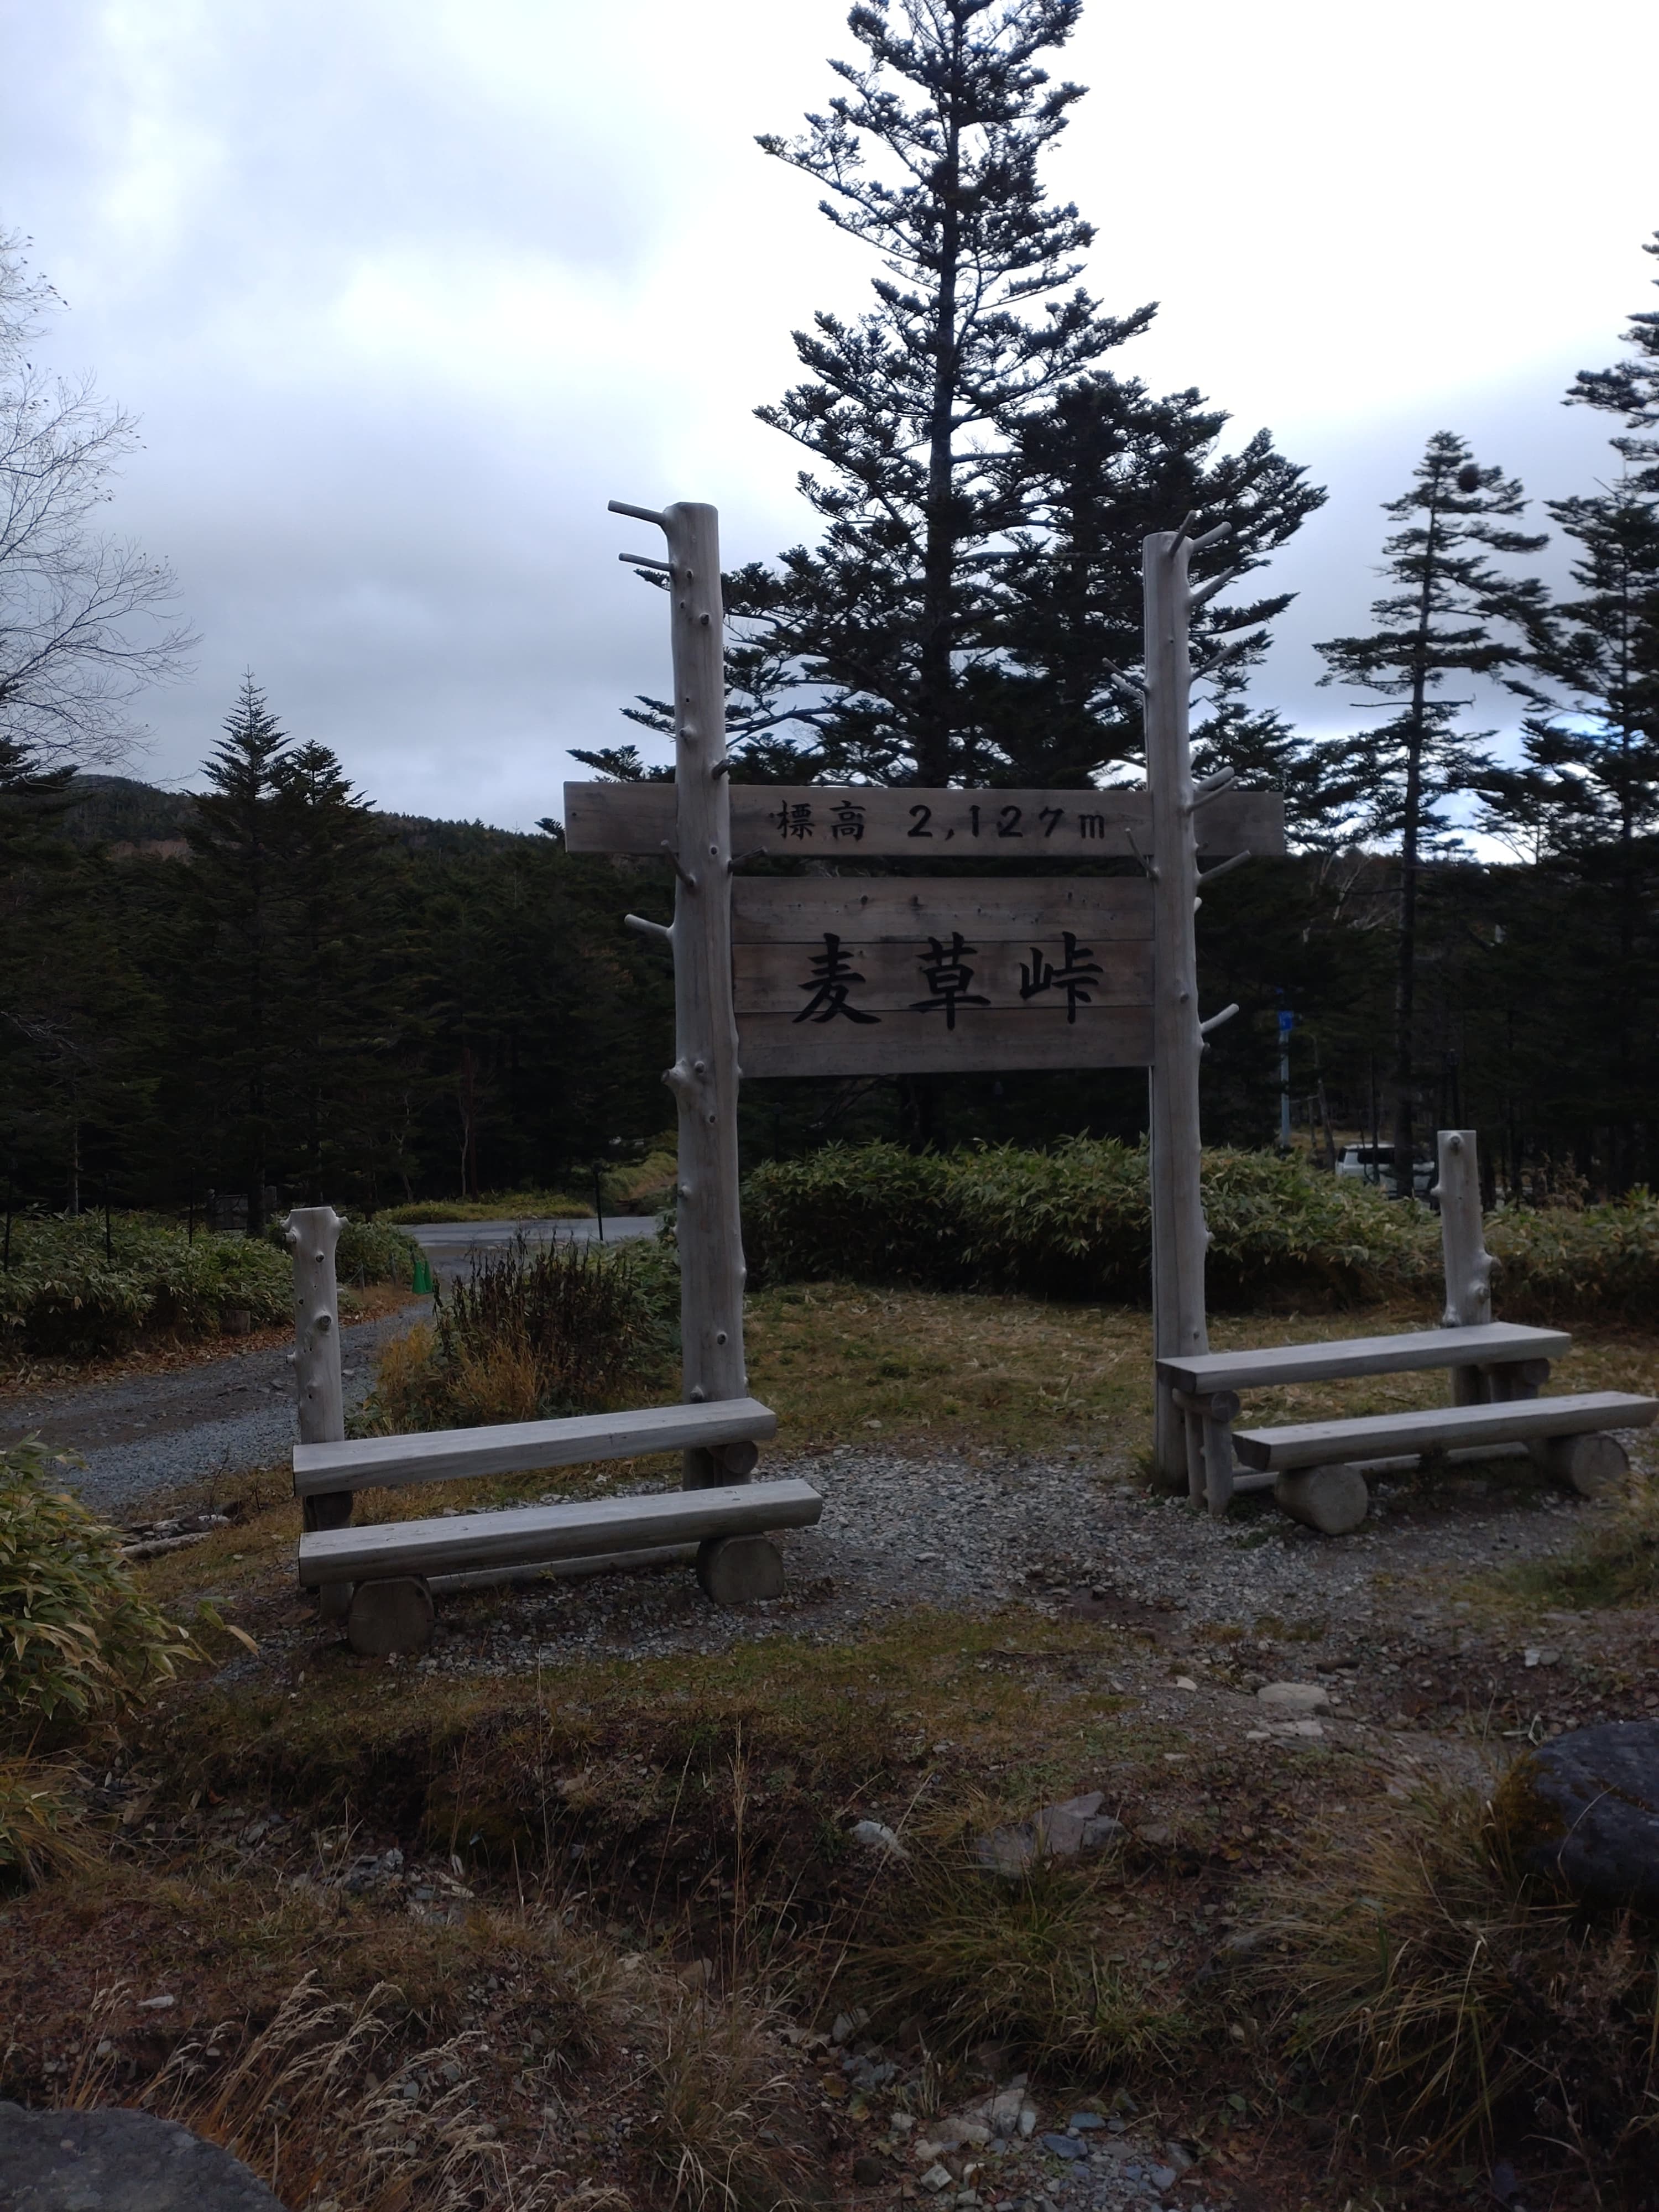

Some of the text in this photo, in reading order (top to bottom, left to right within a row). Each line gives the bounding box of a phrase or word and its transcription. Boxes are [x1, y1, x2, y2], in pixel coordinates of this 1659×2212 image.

[776, 800, 866, 841] 標高
[791, 931, 1104, 1030] 麦草峠
